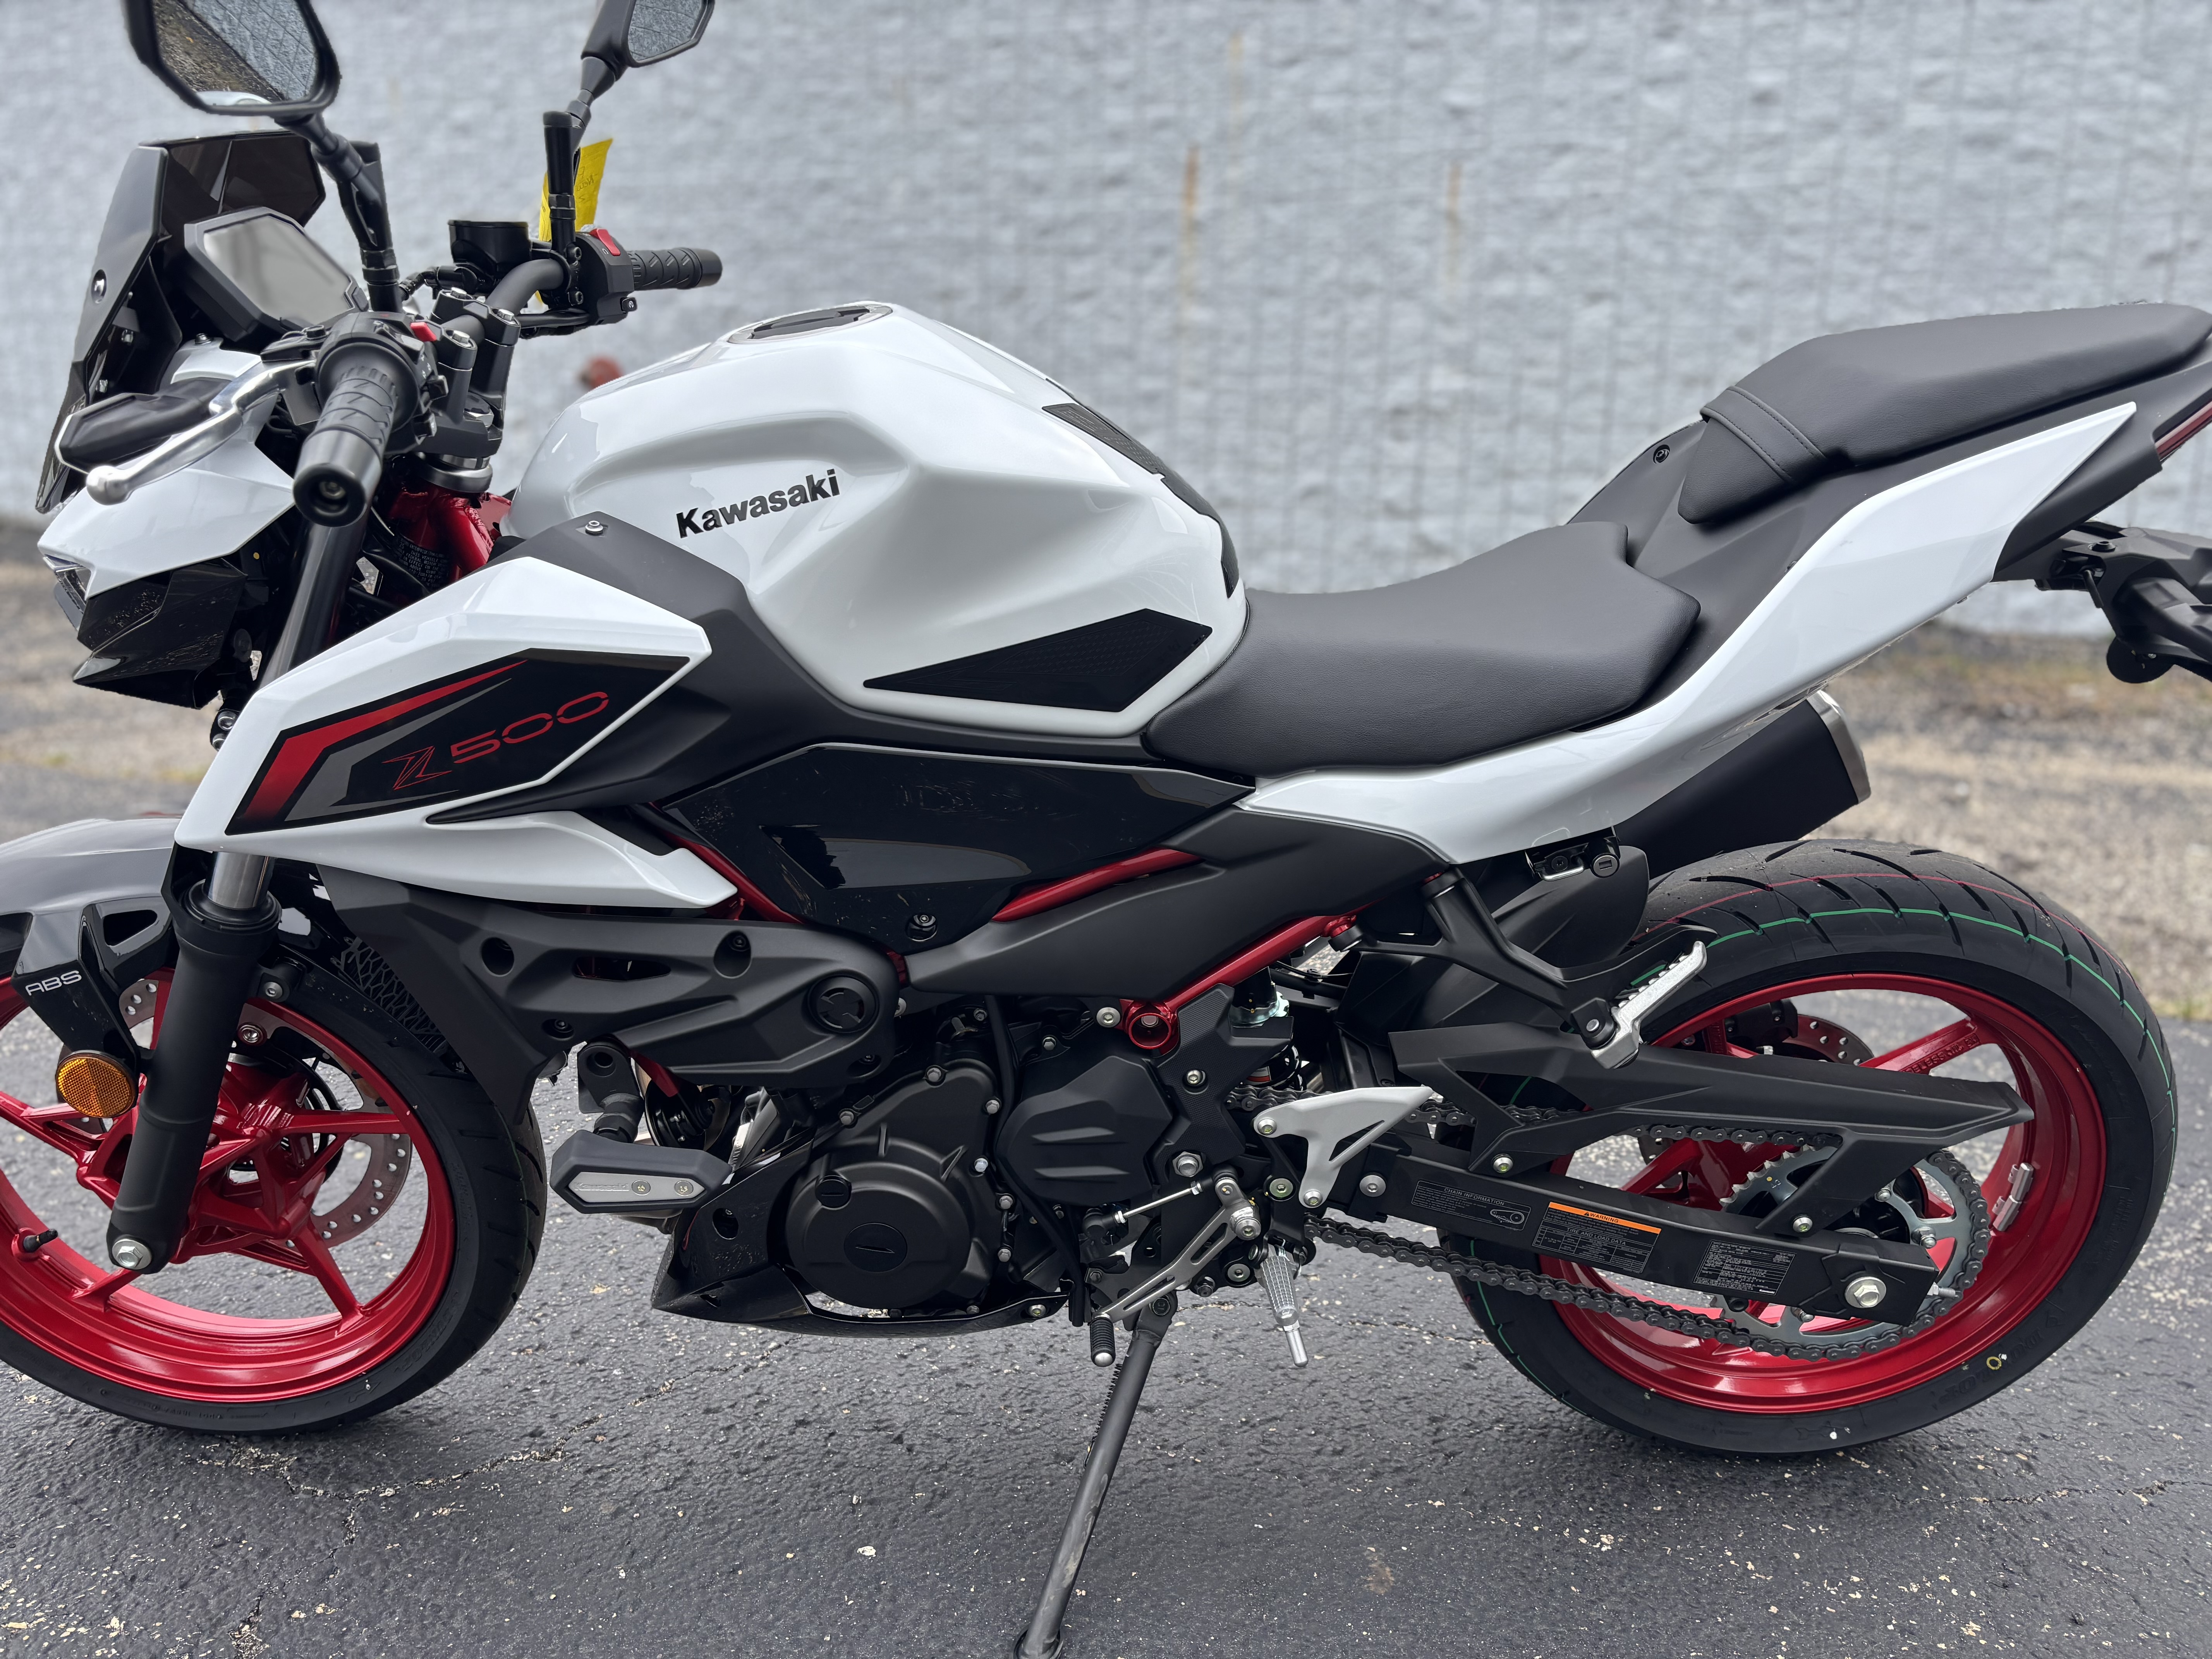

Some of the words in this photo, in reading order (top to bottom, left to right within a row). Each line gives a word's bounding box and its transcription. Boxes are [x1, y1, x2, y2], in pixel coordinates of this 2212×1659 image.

[676, 468, 840, 539] Kawasaki
[25, 970, 82, 996] ABS
[1444, 1188, 1463, 1196] CHAIN
[1463, 1192, 1505, 1206] INFORMATION
[1589, 1212, 1619, 1223] WARNING
